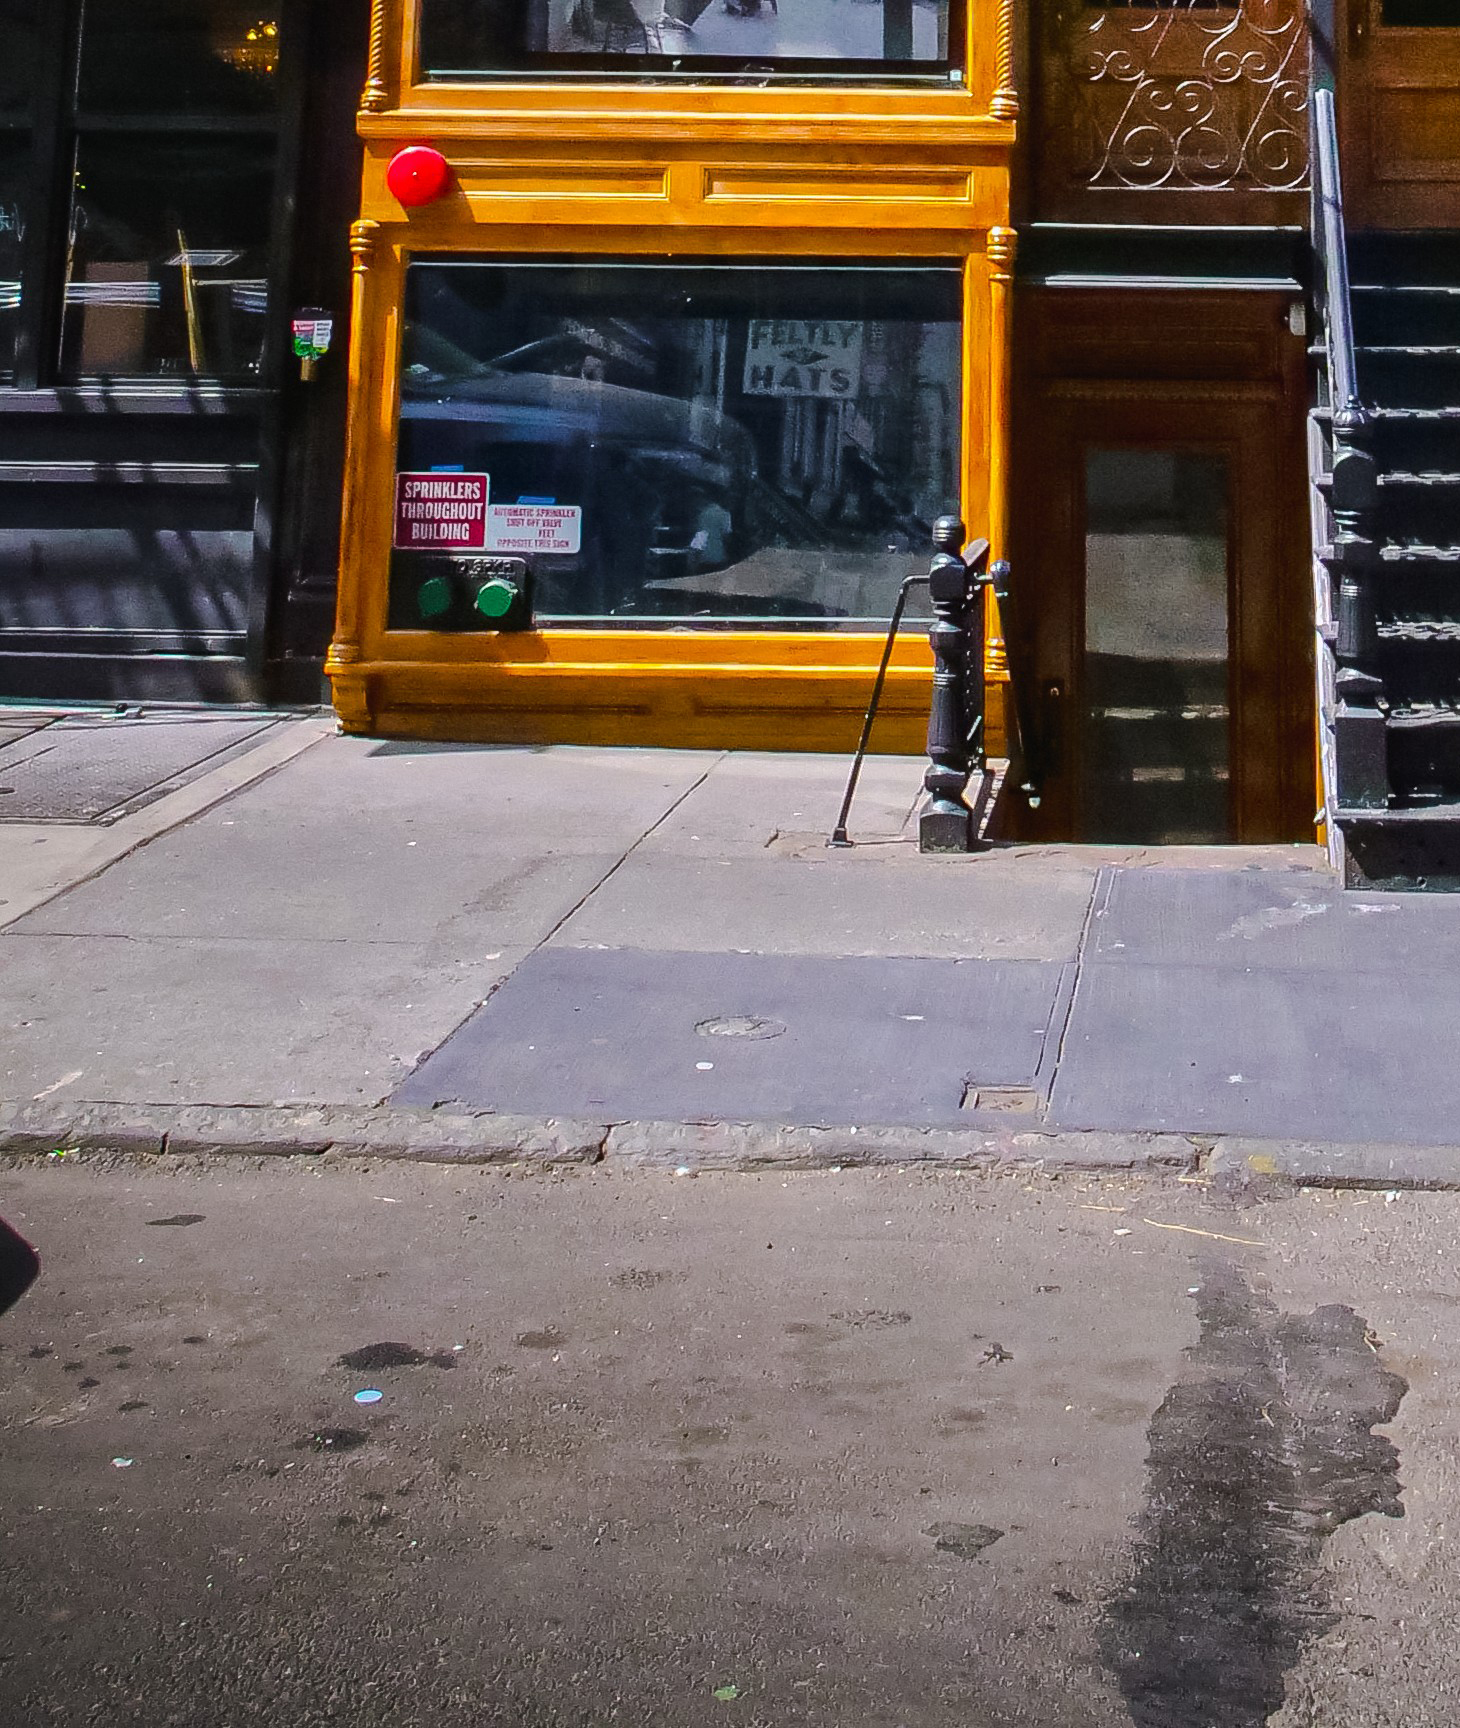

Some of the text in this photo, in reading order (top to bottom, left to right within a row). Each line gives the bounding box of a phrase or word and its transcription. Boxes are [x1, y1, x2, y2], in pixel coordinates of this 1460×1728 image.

[750, 365, 850, 393] HATS
[405, 481, 481, 500] SPRINKLERS
[402, 502, 483, 520] THROUGHOUT
[494, 507, 576, 518] AUTOMATIC SPRINKLER
[507, 518, 525, 527] SHUT
[527, 518, 541, 527] OFF
[412, 522, 470, 541] BUILDING
[538, 529, 555, 538] FEET
[535, 539, 551, 548] THIS
[553, 540, 569, 548] SIGN
